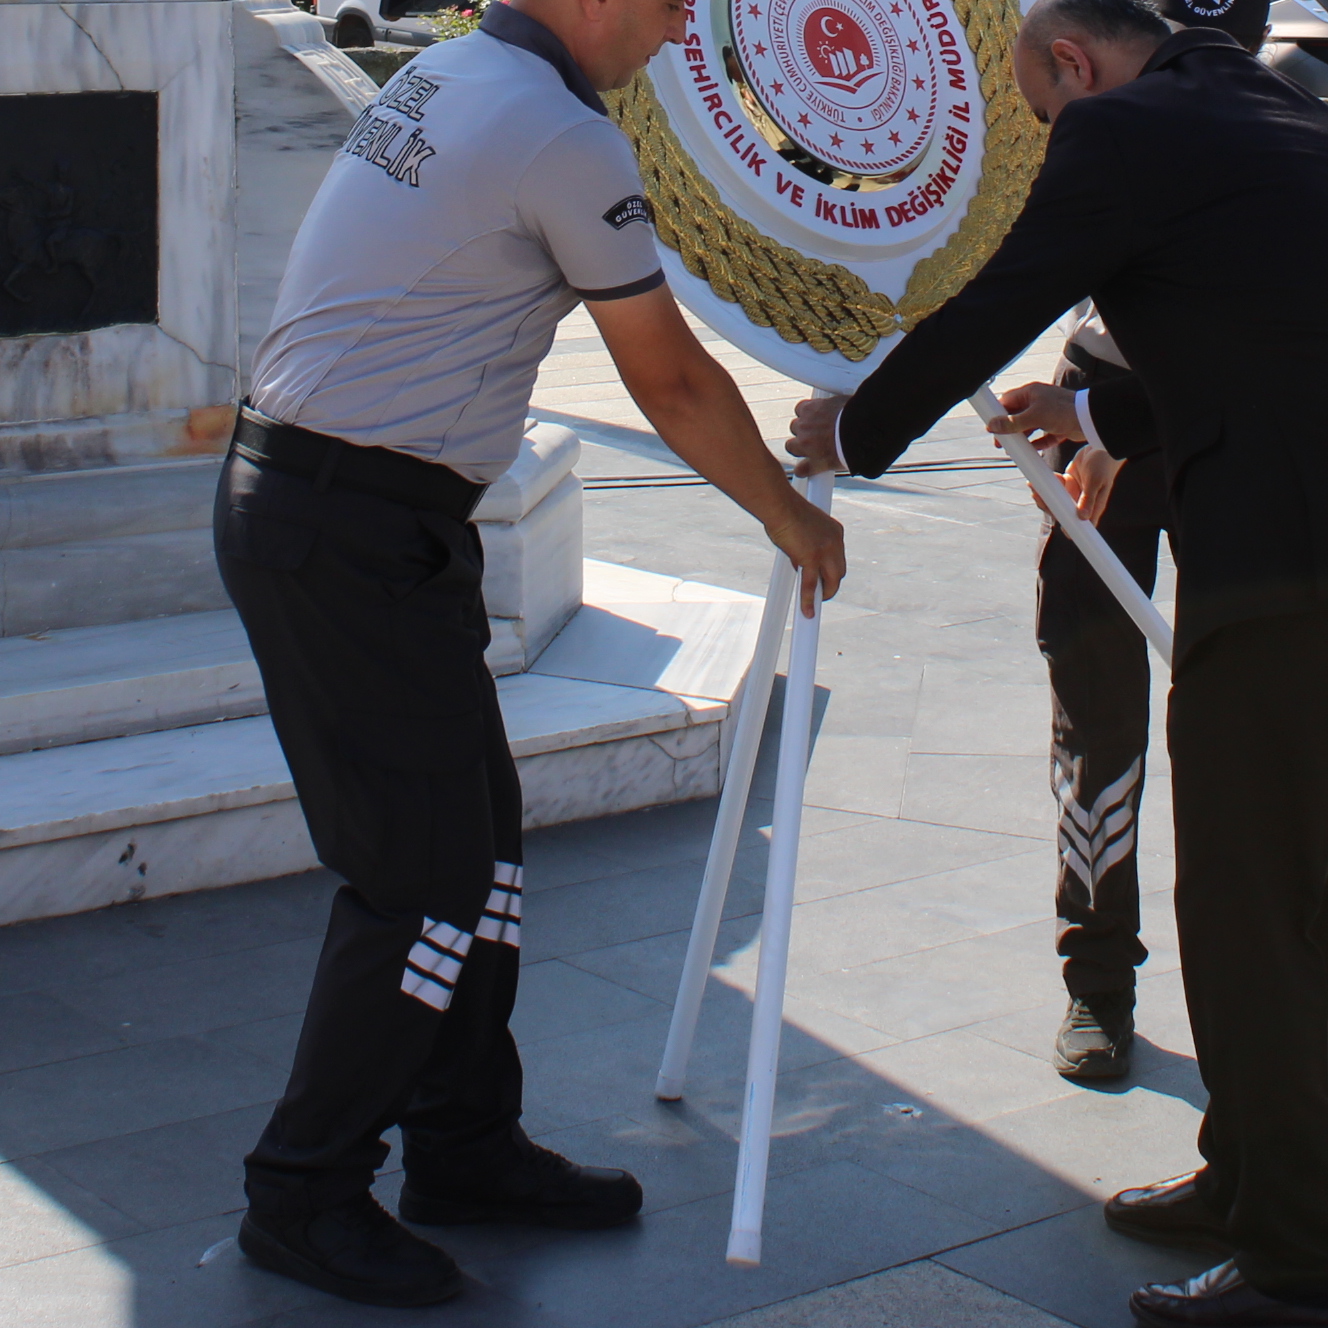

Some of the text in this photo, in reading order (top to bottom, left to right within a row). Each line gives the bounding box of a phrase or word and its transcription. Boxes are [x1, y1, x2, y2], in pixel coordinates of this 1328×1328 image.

[770, 14, 808, 93] CUMHURİYETİ
[379, 66, 440, 122] ÖZEL
[804, 91, 846, 123] TÜRKİYE
[776, 172, 806, 208] VE
[815, 192, 881, 229] İKLİM
[885, 125, 970, 227] DEĞİŞİKLİĞİ
[948, 101, 971, 123] İL
[626, 200, 643, 209] ÖZEL
